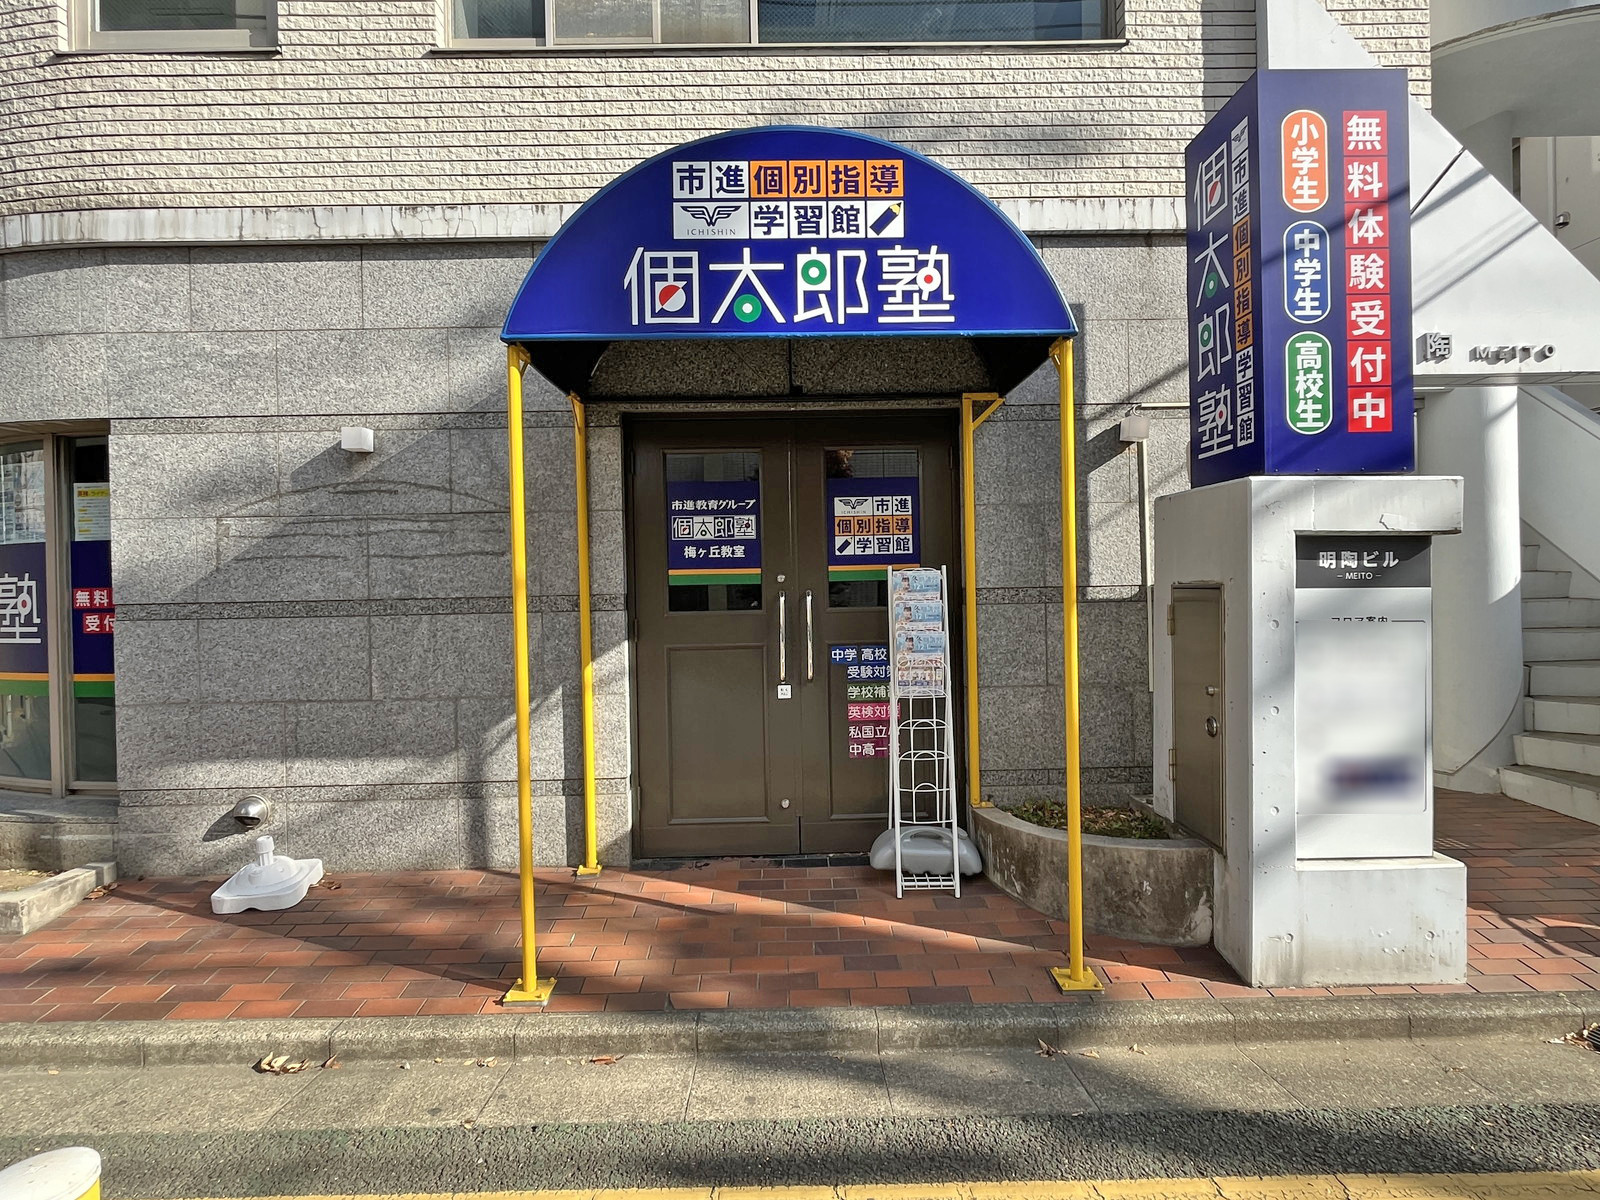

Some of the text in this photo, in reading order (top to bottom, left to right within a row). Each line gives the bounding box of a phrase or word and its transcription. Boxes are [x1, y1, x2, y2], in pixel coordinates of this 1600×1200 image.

[1290, 116, 1320, 204] 小学生
[676, 163, 900, 196] 市進個別指導
[752, 203, 861, 236] 学習館
[686, 227, 737, 237] ICHISHIN
[1293, 228, 1323, 317] 中学生
[1346, 114, 1387, 429] 無料体験受付中
[623, 244, 956, 326] 個太郎塾
[1193, 141, 1234, 460] 個太郎塾
[1232, 149, 1253, 443] 市進個別指導学習館
[1294, 340, 1325, 429] 高校生
[670, 498, 757, 512] 市進教育グループ
[874, 497, 910, 514] 市進
[671, 515, 757, 540] 個太郎塾
[836, 517, 911, 535] 個別指導
[856, 536, 911, 554] 学習館
[1318, 550, 1400, 570] 明陶ビル
[1344, 571, 1373, 581] MEITO
[0, 572, 42, 644] 塾
[75, 589, 109, 607] 無料
[831, 647, 888, 662] 中学 高校
[847, 685, 891, 699] 学校補
[848, 724, 891, 739] 私国立
[849, 742, 889, 756] 中高一
